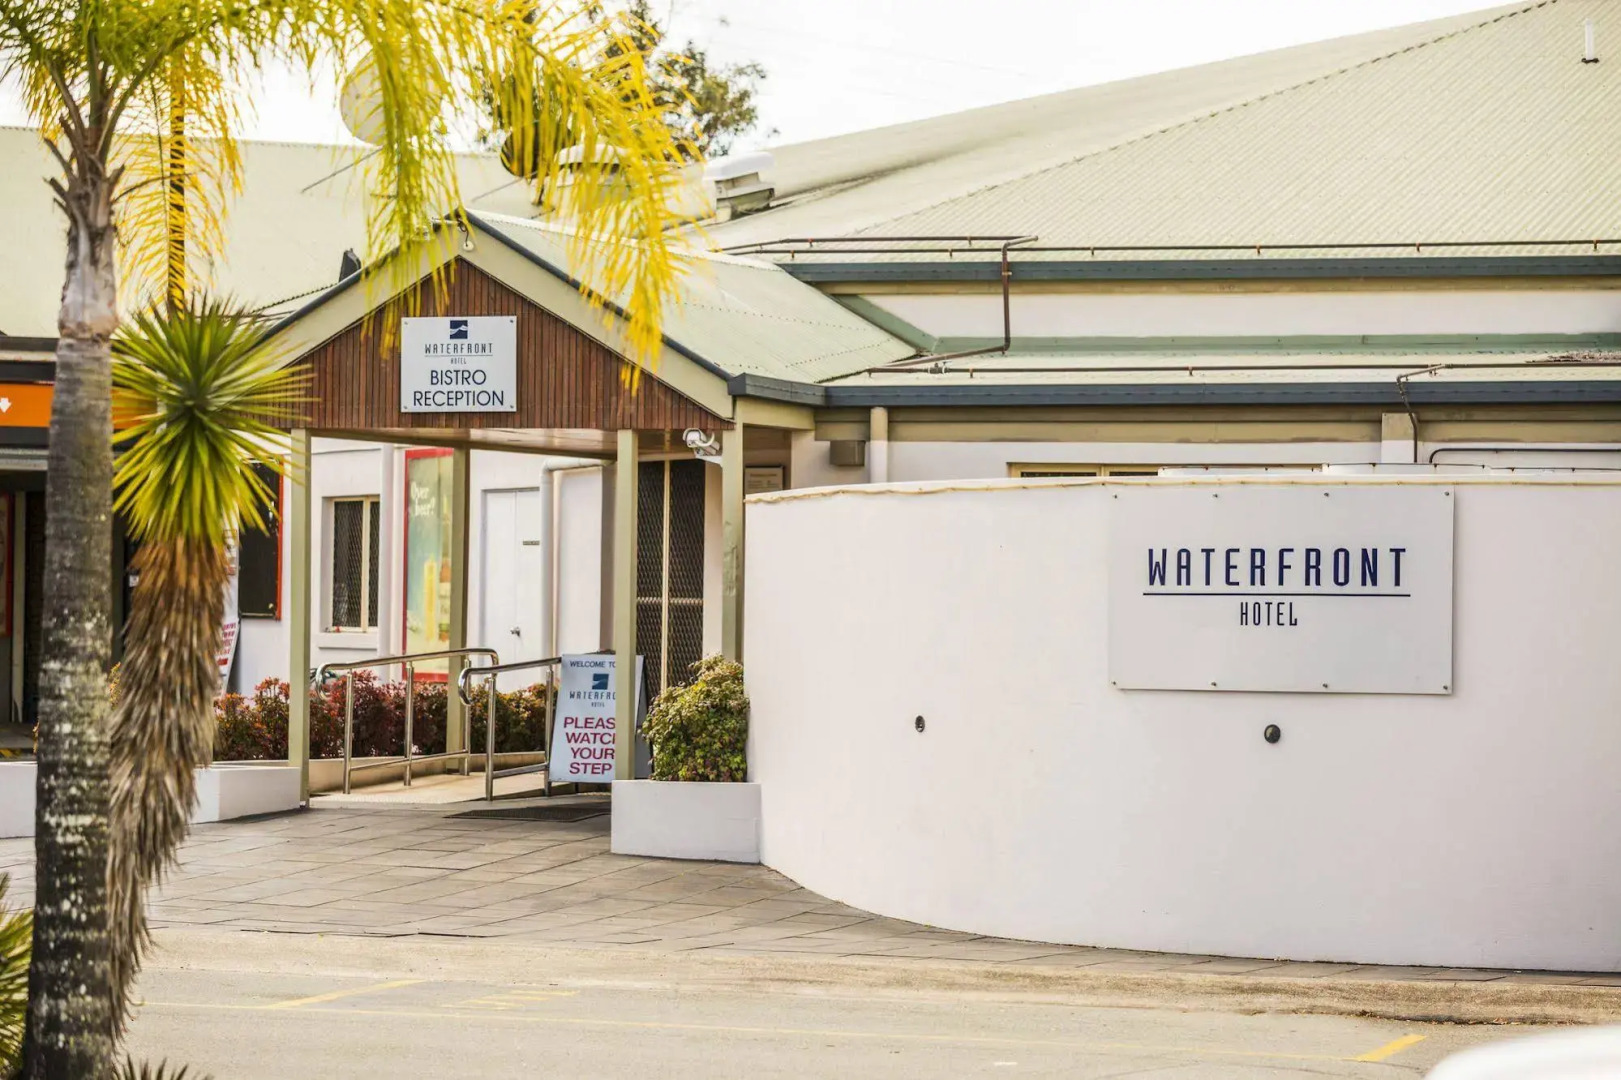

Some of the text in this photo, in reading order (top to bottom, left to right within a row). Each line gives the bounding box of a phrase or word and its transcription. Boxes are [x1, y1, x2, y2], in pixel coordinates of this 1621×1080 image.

[424, 343, 493, 354] WATERFRONT
[430, 369, 487, 386] BISTRO
[413, 390, 504, 407] RECEPTION
[1148, 547, 1406, 587] WATERFRONT
[1240, 601, 1298, 626] HOTEL
[570, 660, 606, 668] WELCOME
[569, 691, 616, 700] WATERFRO
[563, 717, 616, 730] PLEAS
[565, 732, 616, 745] WATC
[570, 747, 615, 760] YOUR
[569, 762, 612, 775] STEP
